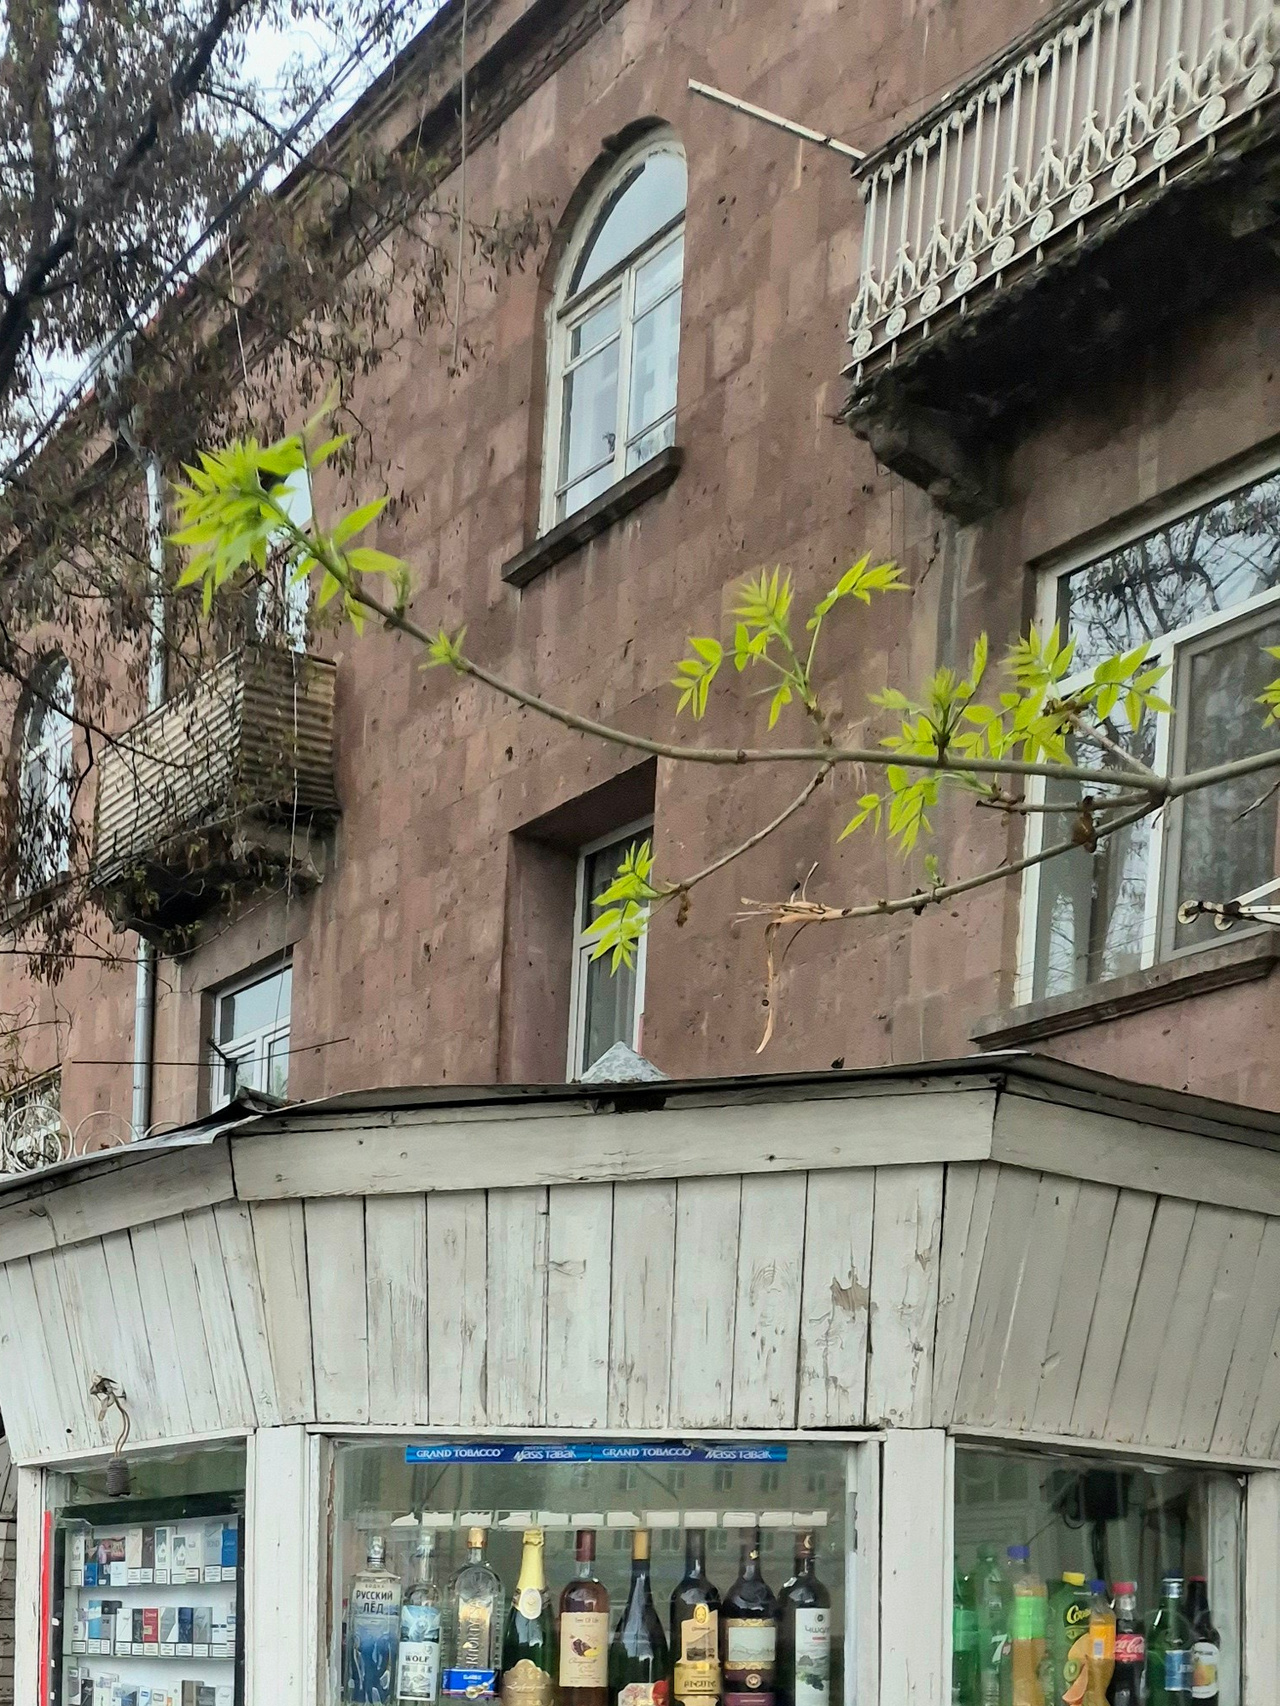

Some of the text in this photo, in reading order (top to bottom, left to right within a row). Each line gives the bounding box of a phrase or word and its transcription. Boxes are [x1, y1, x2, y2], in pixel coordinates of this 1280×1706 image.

[416, 1449, 451, 1458] GRAND
[602, 1448, 639, 1457] GRAND
[641, 1448, 692, 1457] TOBACCO
[356, 1590, 393, 1600] РУССКИЙ
[363, 1602, 385, 1615] ЛЁД
